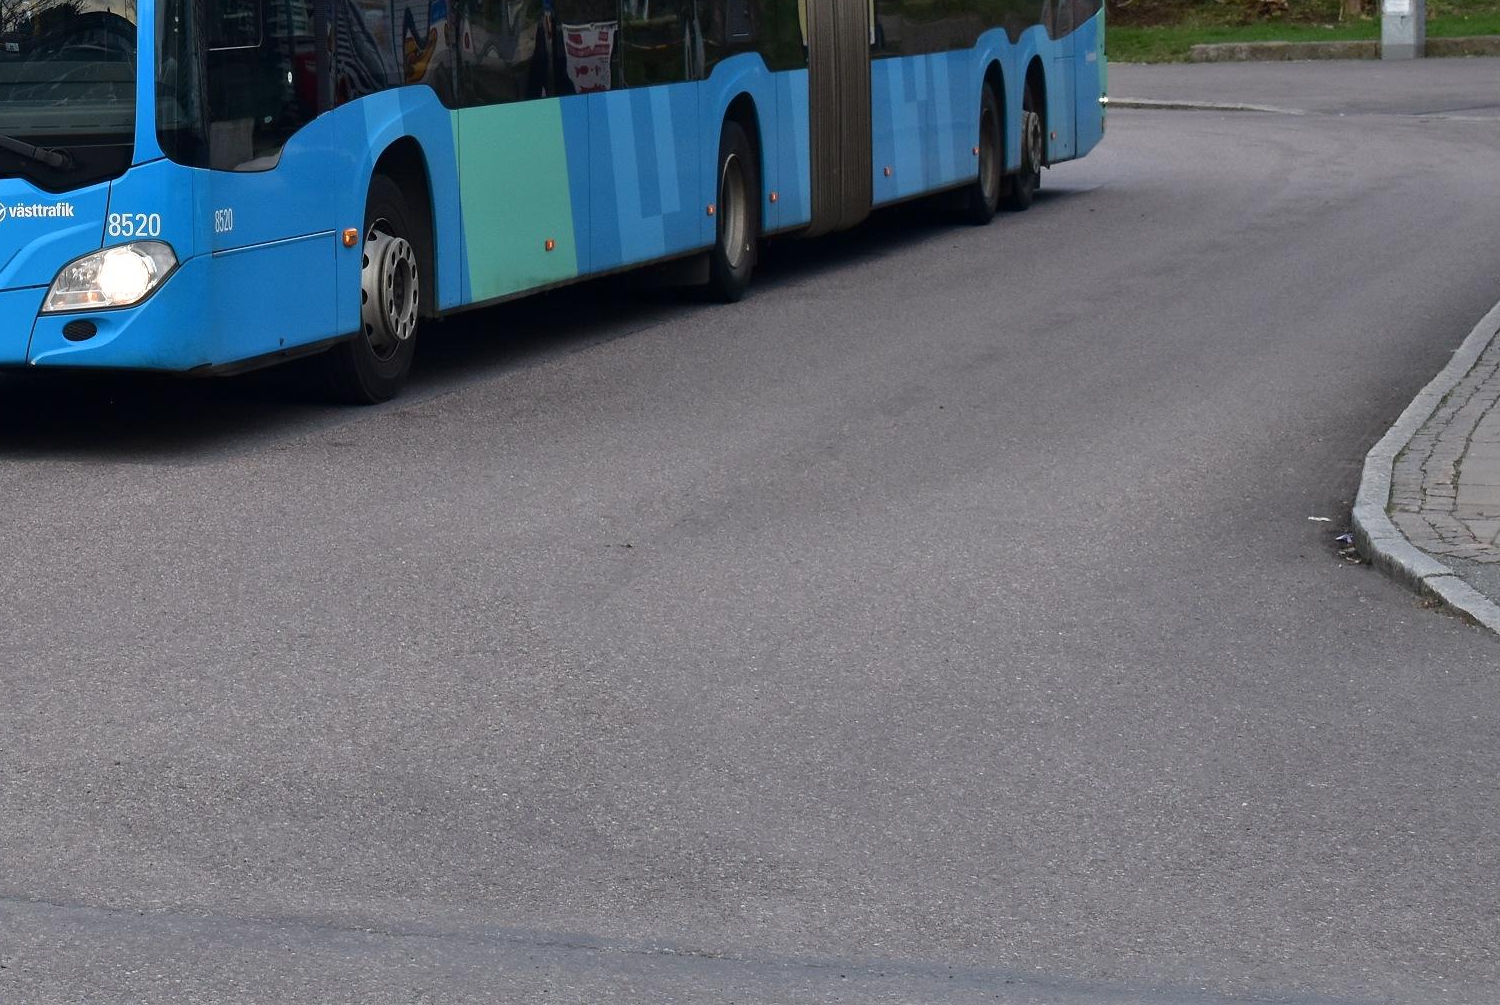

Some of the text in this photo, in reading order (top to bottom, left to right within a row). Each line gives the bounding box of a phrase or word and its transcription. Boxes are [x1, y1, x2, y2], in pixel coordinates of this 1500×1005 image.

[8, 202, 74, 218] västtrafik
[214, 208, 234, 233] 8520
[108, 213, 161, 237] 8520
